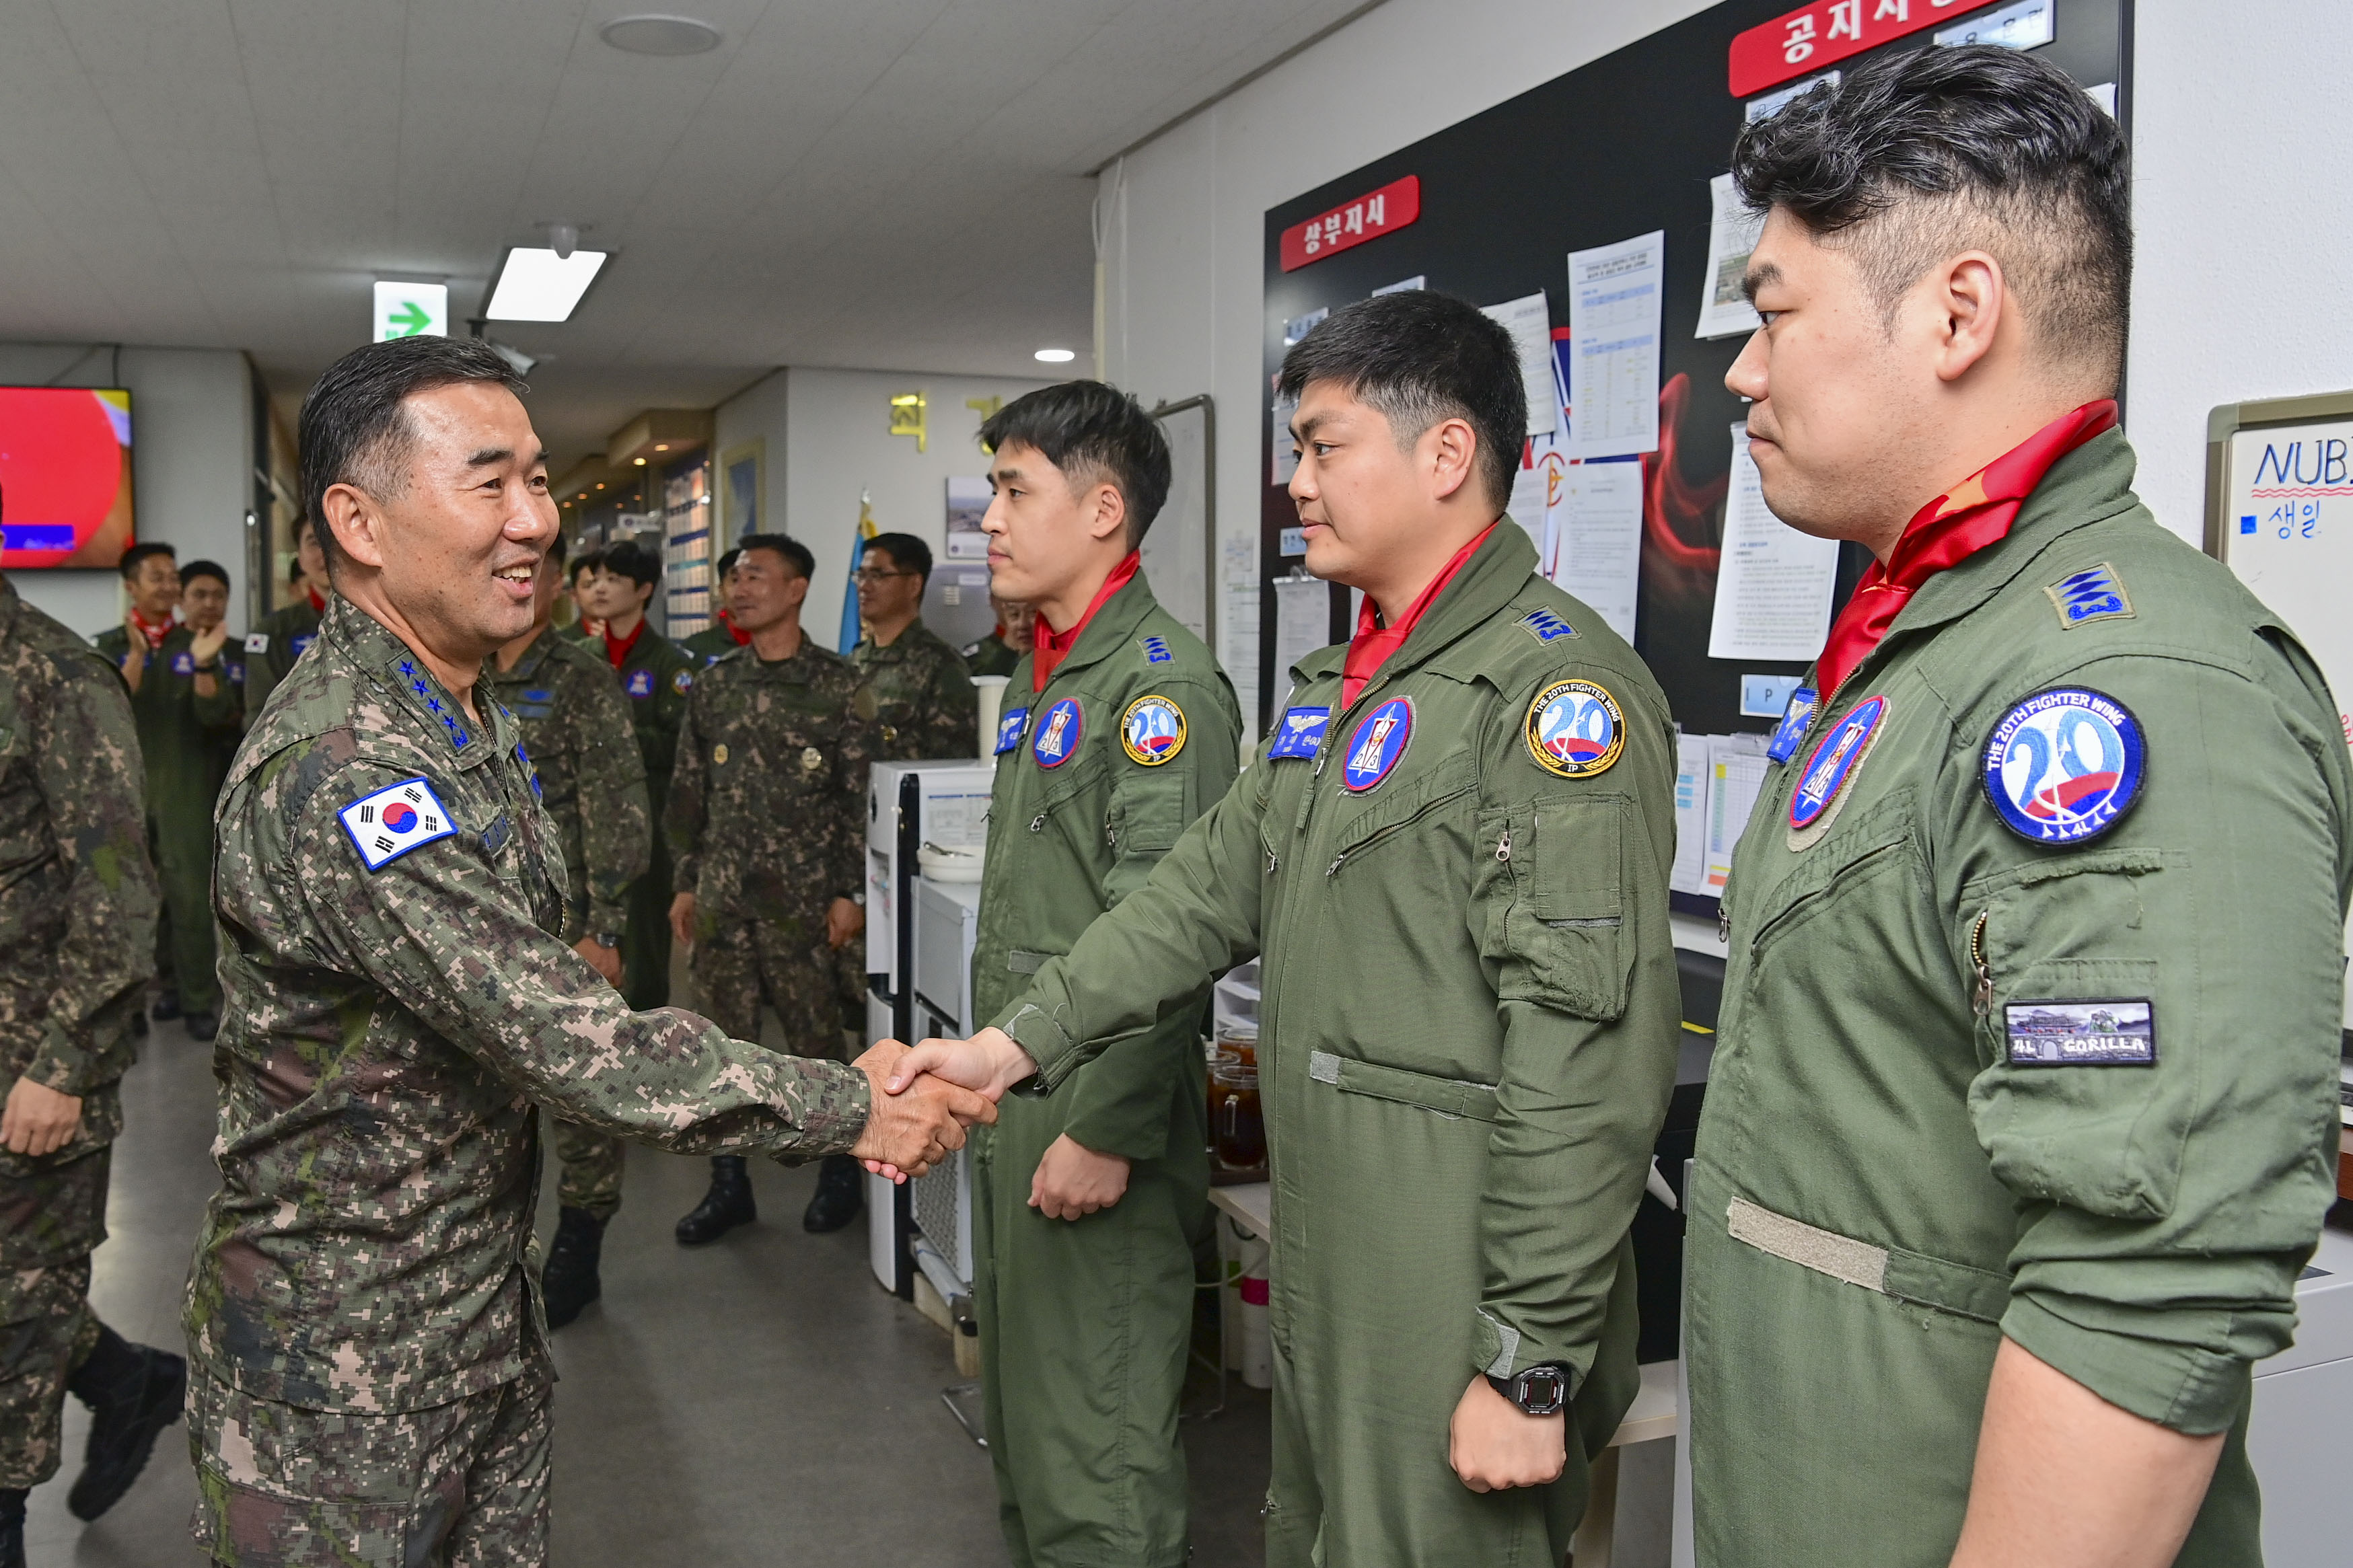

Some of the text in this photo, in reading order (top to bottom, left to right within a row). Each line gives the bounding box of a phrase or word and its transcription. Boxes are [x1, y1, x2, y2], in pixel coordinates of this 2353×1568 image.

[1304, 194, 1385, 254] 상부지시
[2253, 437, 2353, 484] NUB
[2268, 500, 2320, 539] 생일
[1140, 698, 1166, 706] FIGHTER
[1165, 702, 1180, 717] WING
[1533, 683, 1620, 722] THE 20TH FIGHTER WING
[1987, 692, 2126, 772] THE 20TH FIGHTER WING
[1042, 737, 1058, 750] 2 3
[1355, 753, 1378, 766] 2 3
[1567, 764, 1579, 772] IP
[2071, 820, 2092, 837] 4L
[2062, 1037, 2146, 1053] GORILLA
